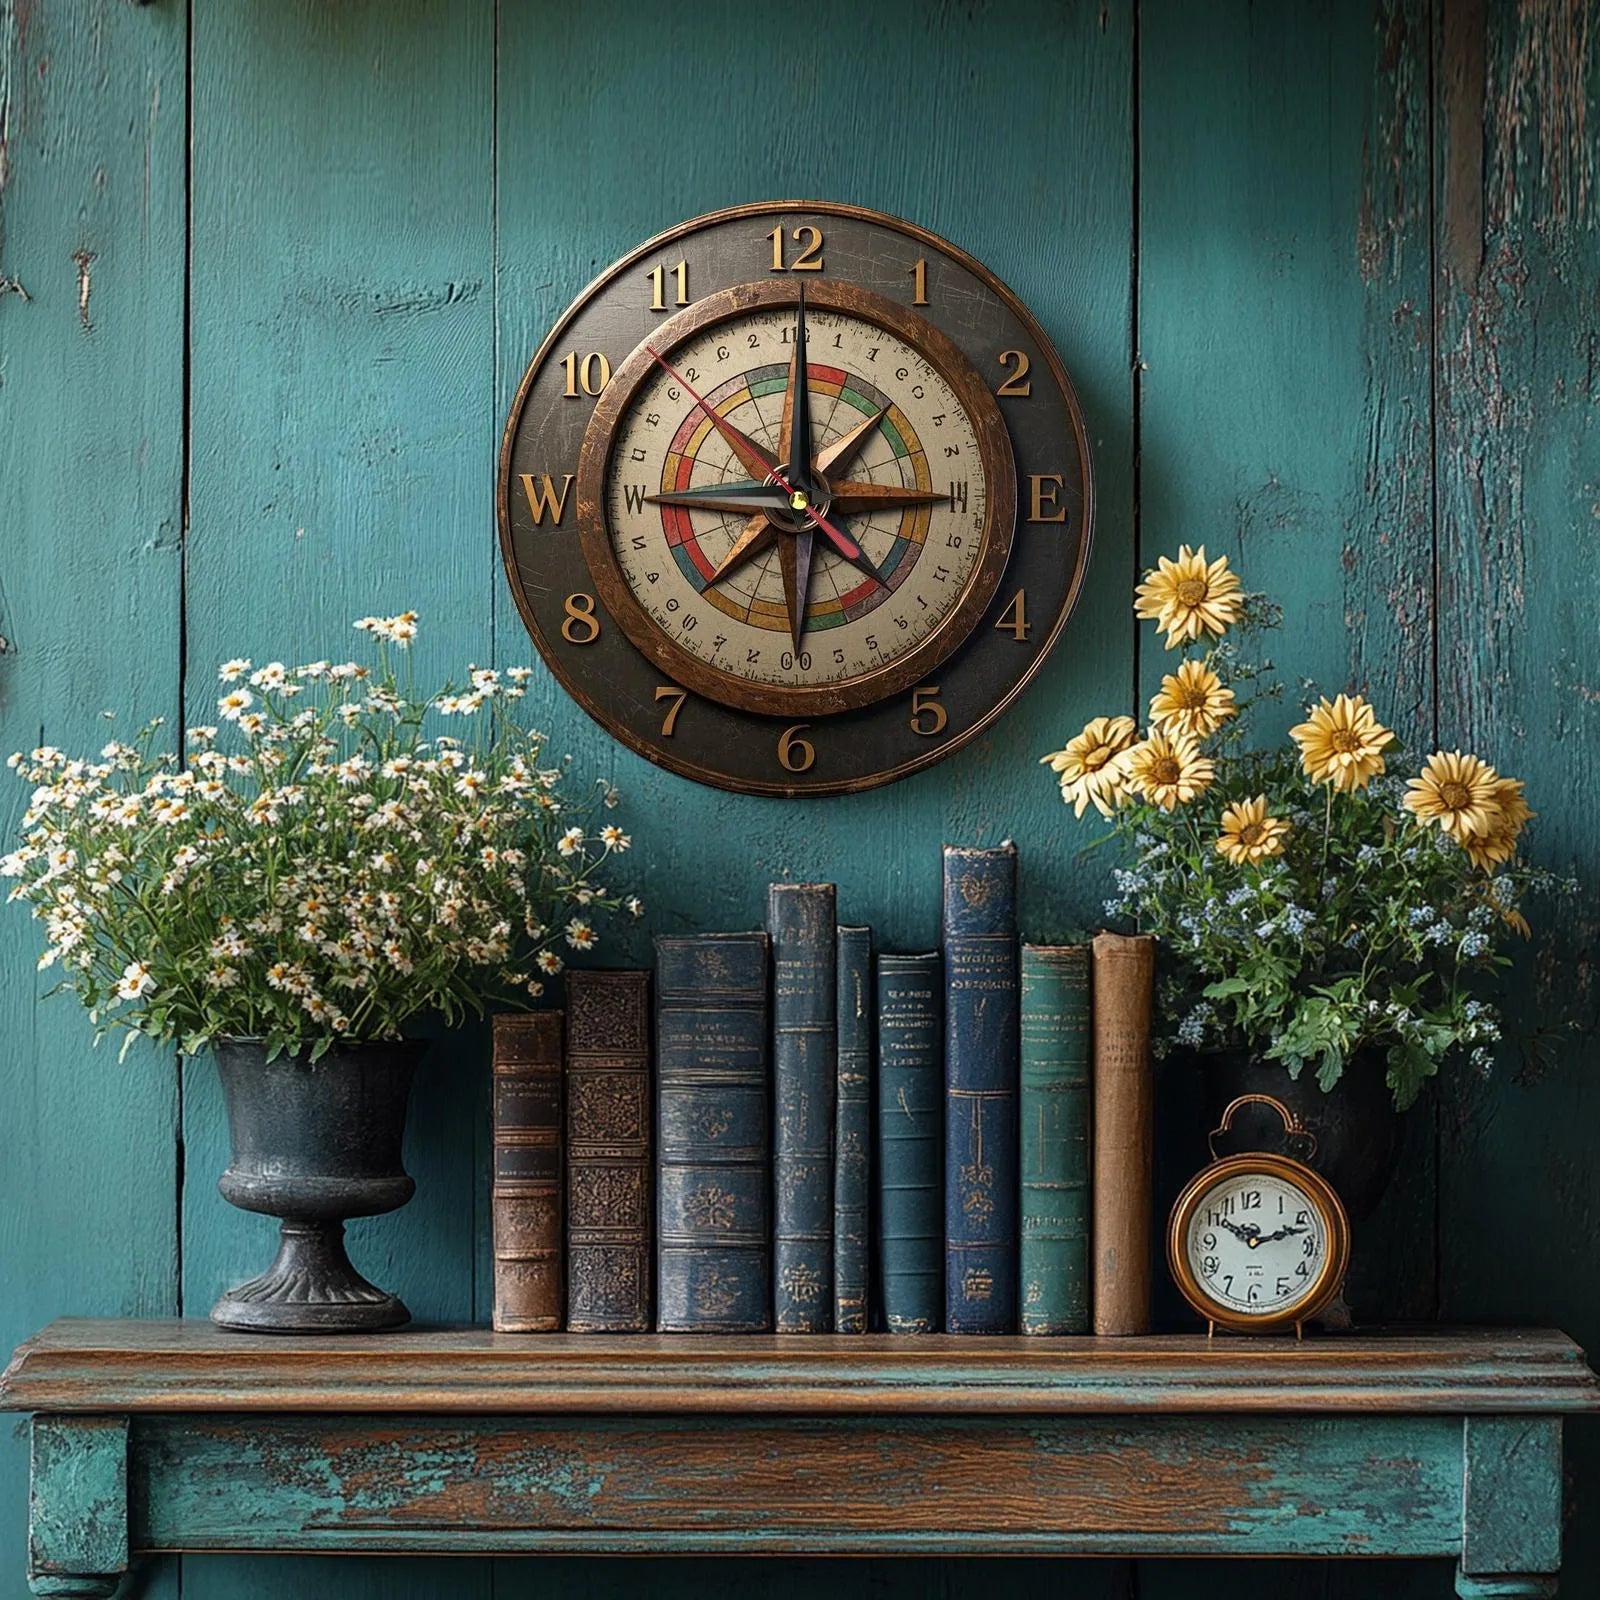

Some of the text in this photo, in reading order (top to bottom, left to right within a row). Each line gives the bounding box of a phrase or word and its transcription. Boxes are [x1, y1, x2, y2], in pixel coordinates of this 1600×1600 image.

[766, 226, 824, 271] 12
[646, 259, 690, 311] 11
[909, 259, 930, 305] 1
[560, 351, 612, 397] 10
[998, 350, 1032, 397] 2
[519, 474, 575, 526] W
[624, 485, 646, 514] W
[1027, 474, 1066, 522] E
[561, 593, 601, 643] 8
[995, 589, 1032, 641] 4
[655, 686, 689, 736] 7
[911, 686, 948, 735] 5
[777, 724, 816, 772] 6
[1241, 1190, 1261, 1209] 12
[1278, 1195, 1284, 1215] 1
[1203, 1233, 1217, 1250] 9
